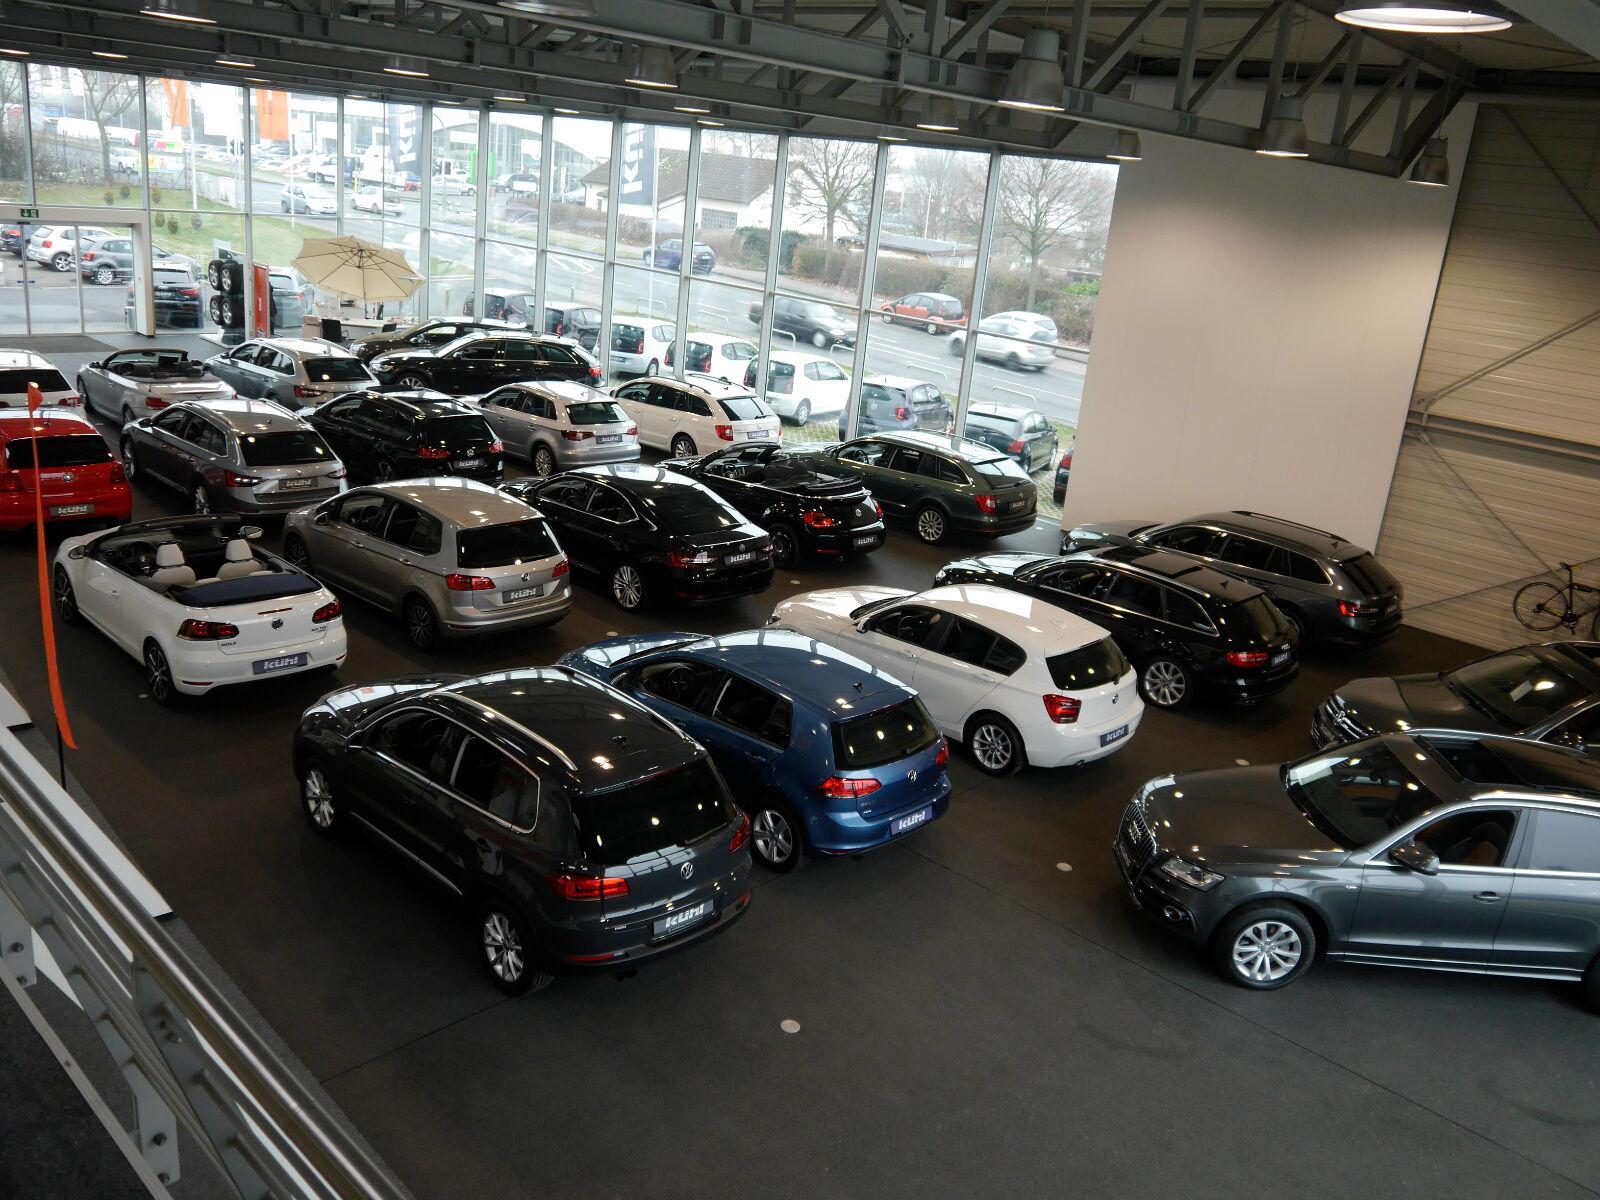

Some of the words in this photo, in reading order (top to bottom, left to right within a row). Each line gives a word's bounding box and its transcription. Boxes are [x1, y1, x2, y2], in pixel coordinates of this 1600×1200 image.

[286, 478, 312, 488] kühl
[58, 504, 88, 514] kühl
[511, 587, 537, 600] kühl
[264, 656, 299, 670] kühl
[898, 811, 926, 830] kühl
[666, 903, 704, 928] kühl
